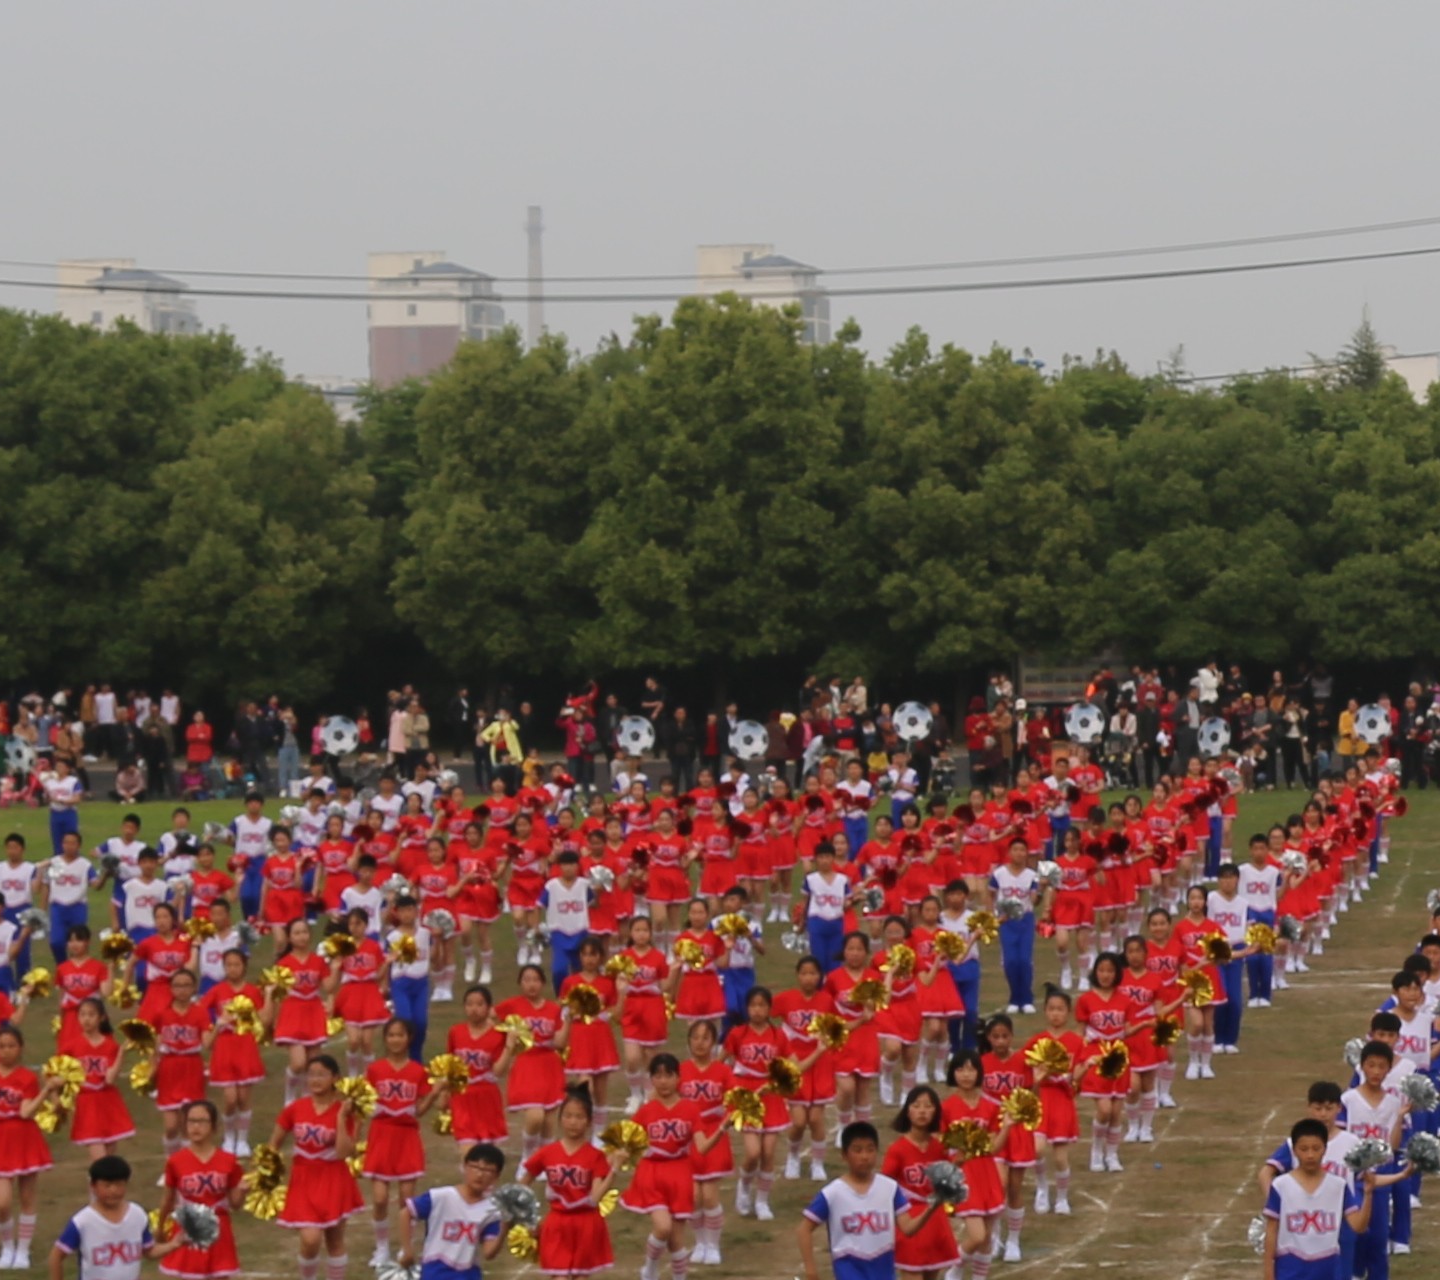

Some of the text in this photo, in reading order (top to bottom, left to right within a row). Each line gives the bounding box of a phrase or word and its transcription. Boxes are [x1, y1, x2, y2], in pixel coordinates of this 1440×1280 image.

[1085, 1010, 1125, 1029] CXU
[377, 1081, 416, 1101] CXU
[679, 1081, 722, 1100] CXU
[983, 1072, 1024, 1091] CXU
[648, 1124, 691, 1145] CXU
[180, 1174, 227, 1196] CXU
[546, 1165, 591, 1189] CXU
[843, 1212, 892, 1233] CXU
[1287, 1210, 1336, 1233] CXU
[93, 1245, 141, 1266] CXU
